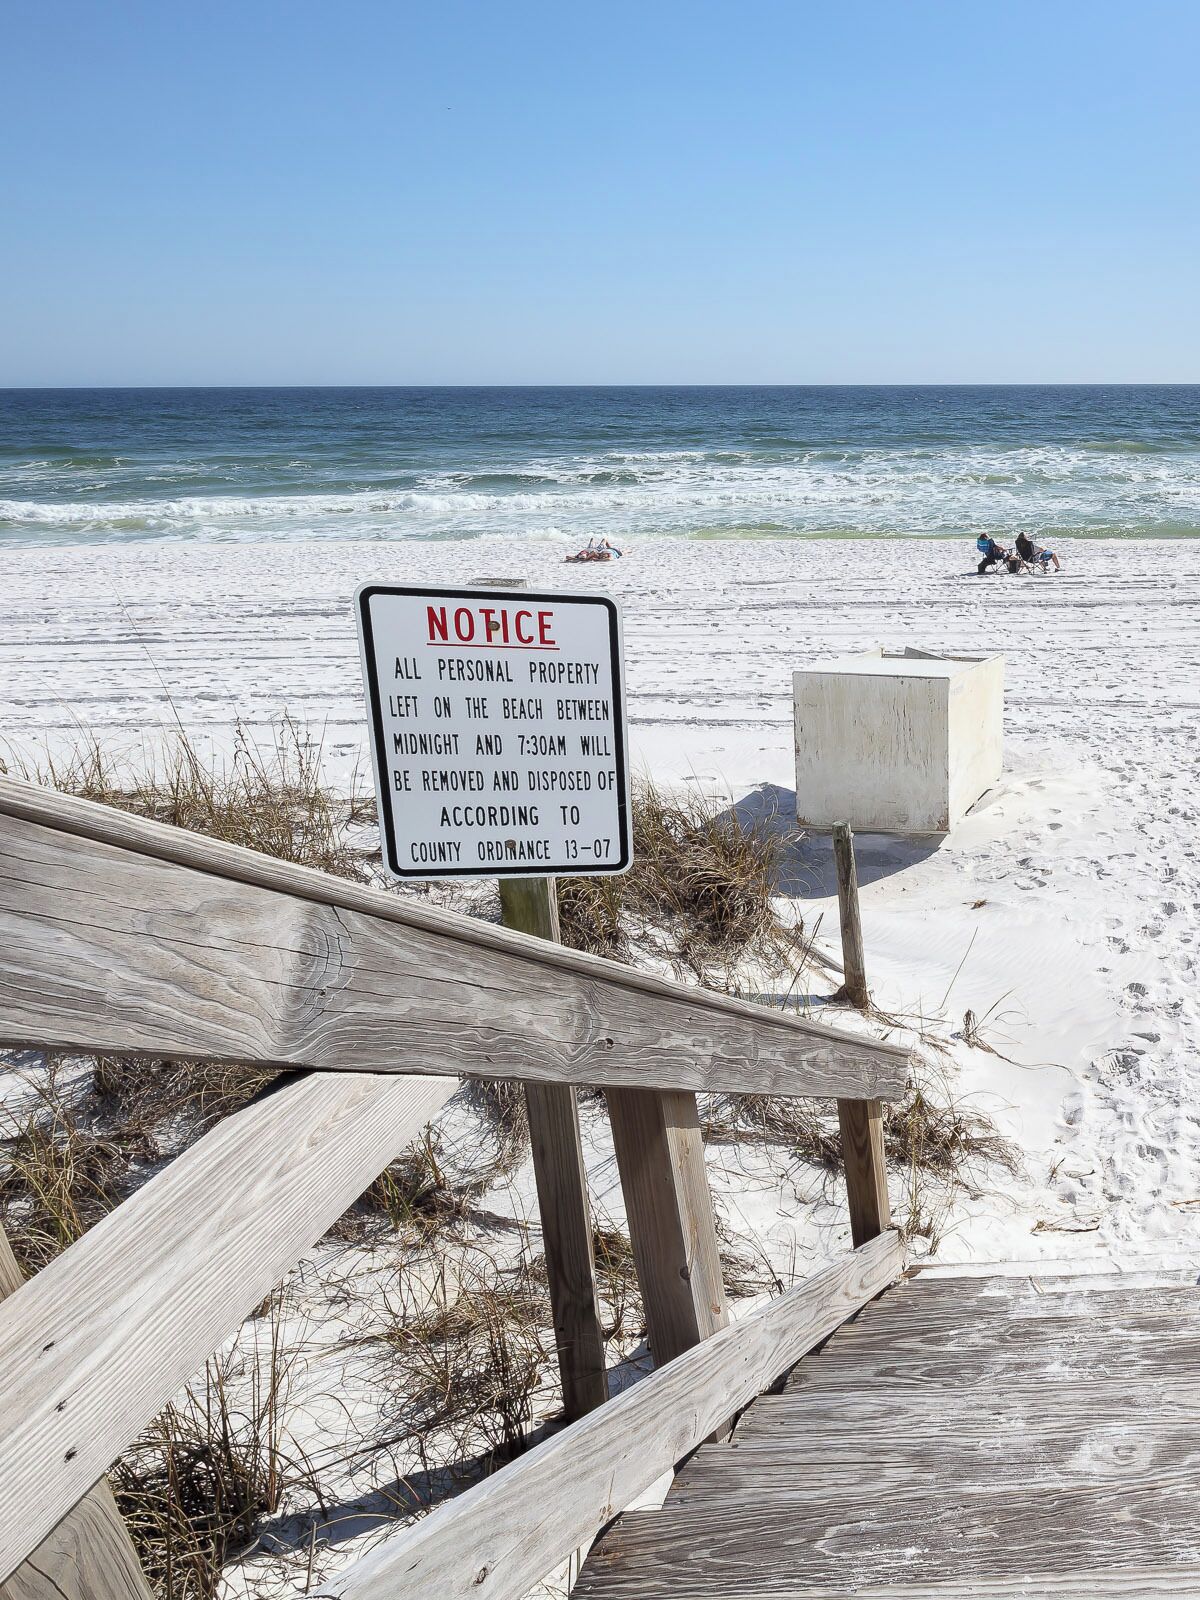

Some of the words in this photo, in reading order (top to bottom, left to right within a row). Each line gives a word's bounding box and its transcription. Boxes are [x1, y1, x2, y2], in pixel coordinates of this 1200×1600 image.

[427, 606, 556, 644] NOTICE
[395, 657, 421, 680] ALL
[438, 659, 513, 682] PERSONAL
[529, 662, 599, 684] PROPERTY
[390, 696, 418, 718] LEFT
[434, 697, 450, 718] ON
[466, 698, 488, 719] THE
[503, 699, 543, 720] BEACH
[557, 700, 609, 721] BETWEEN
[394, 733, 459, 755] MIDNIGHT
[476, 735, 502, 755] AND
[518, 735, 566, 756] 7:30AM
[581, 736, 611, 756] WILL
[394, 771, 411, 791] BE
[423, 771, 484, 791] REMOVED
[493, 771, 518, 791] AND
[529, 771, 591, 791] DISPOSED
[599, 771, 615, 790] OF
[440, 806, 539, 826] ACCORDING
[560, 805, 580, 825] TO
[411, 842, 461, 862] COUNTY
[478, 840, 551, 861] ORDINANCE
[565, 839, 610, 859] 13-07
